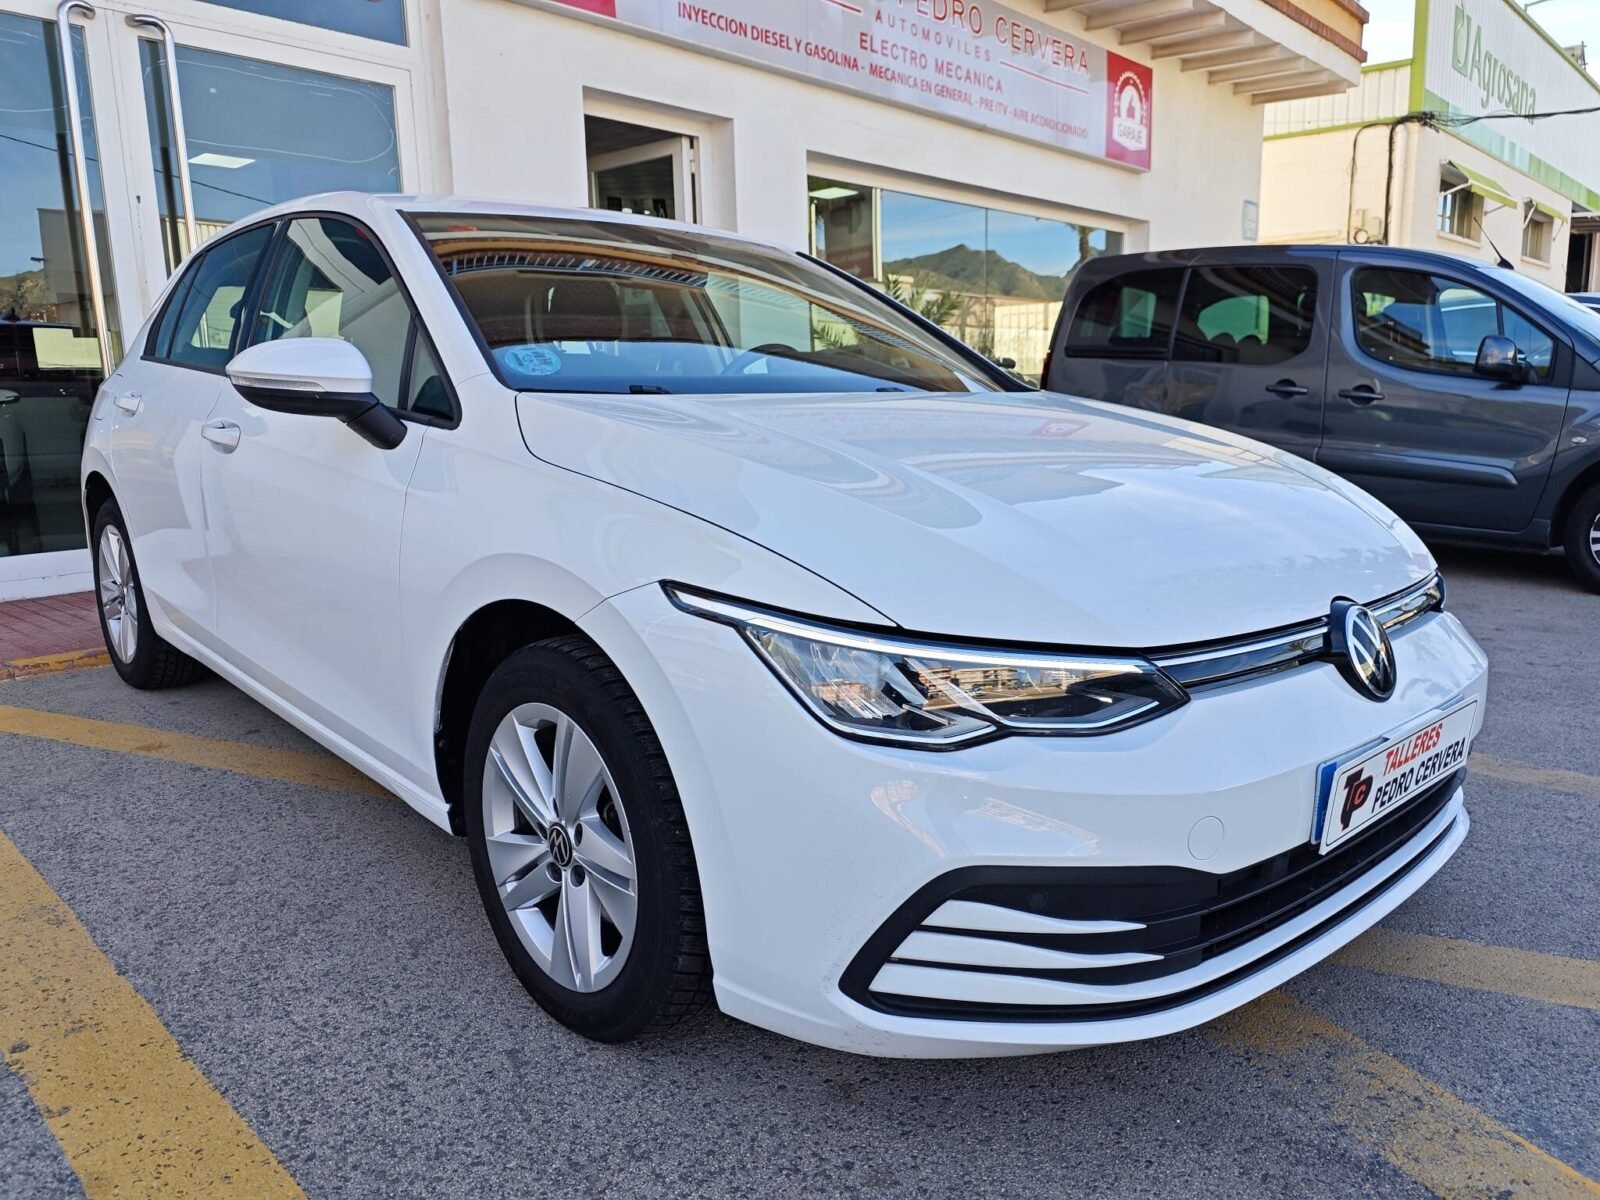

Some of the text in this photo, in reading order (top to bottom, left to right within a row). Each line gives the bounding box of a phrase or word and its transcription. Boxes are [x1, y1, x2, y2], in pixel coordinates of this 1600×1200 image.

[678, 1, 748, 38] INYECCION
[751, 26, 793, 51] DIESEL
[794, 38, 802, 53] Y
[804, 42, 859, 72] GASOLINA
[869, 63, 918, 89] MECANICA
[920, 79, 932, 94] EN
[934, 83, 973, 106] GENERAL
[979, 97, 994, 112] PRE
[995, 101, 1008, 116] ITV
[1013, 107, 1029, 123] AIRE
[1030, 112, 1089, 139] ACONDICIONADO
[860, 32, 1003, 93] ELECTRO MECANICA
[875, 9, 991, 62] AUTOMOVILES
[898, 0, 1089, 74] EDRO CERVERA
[1469, 24, 1536, 125] Agrosana
[1371, 736, 1466, 814] PEDRO CERVERA
[1383, 722, 1443, 777] TALLERES
